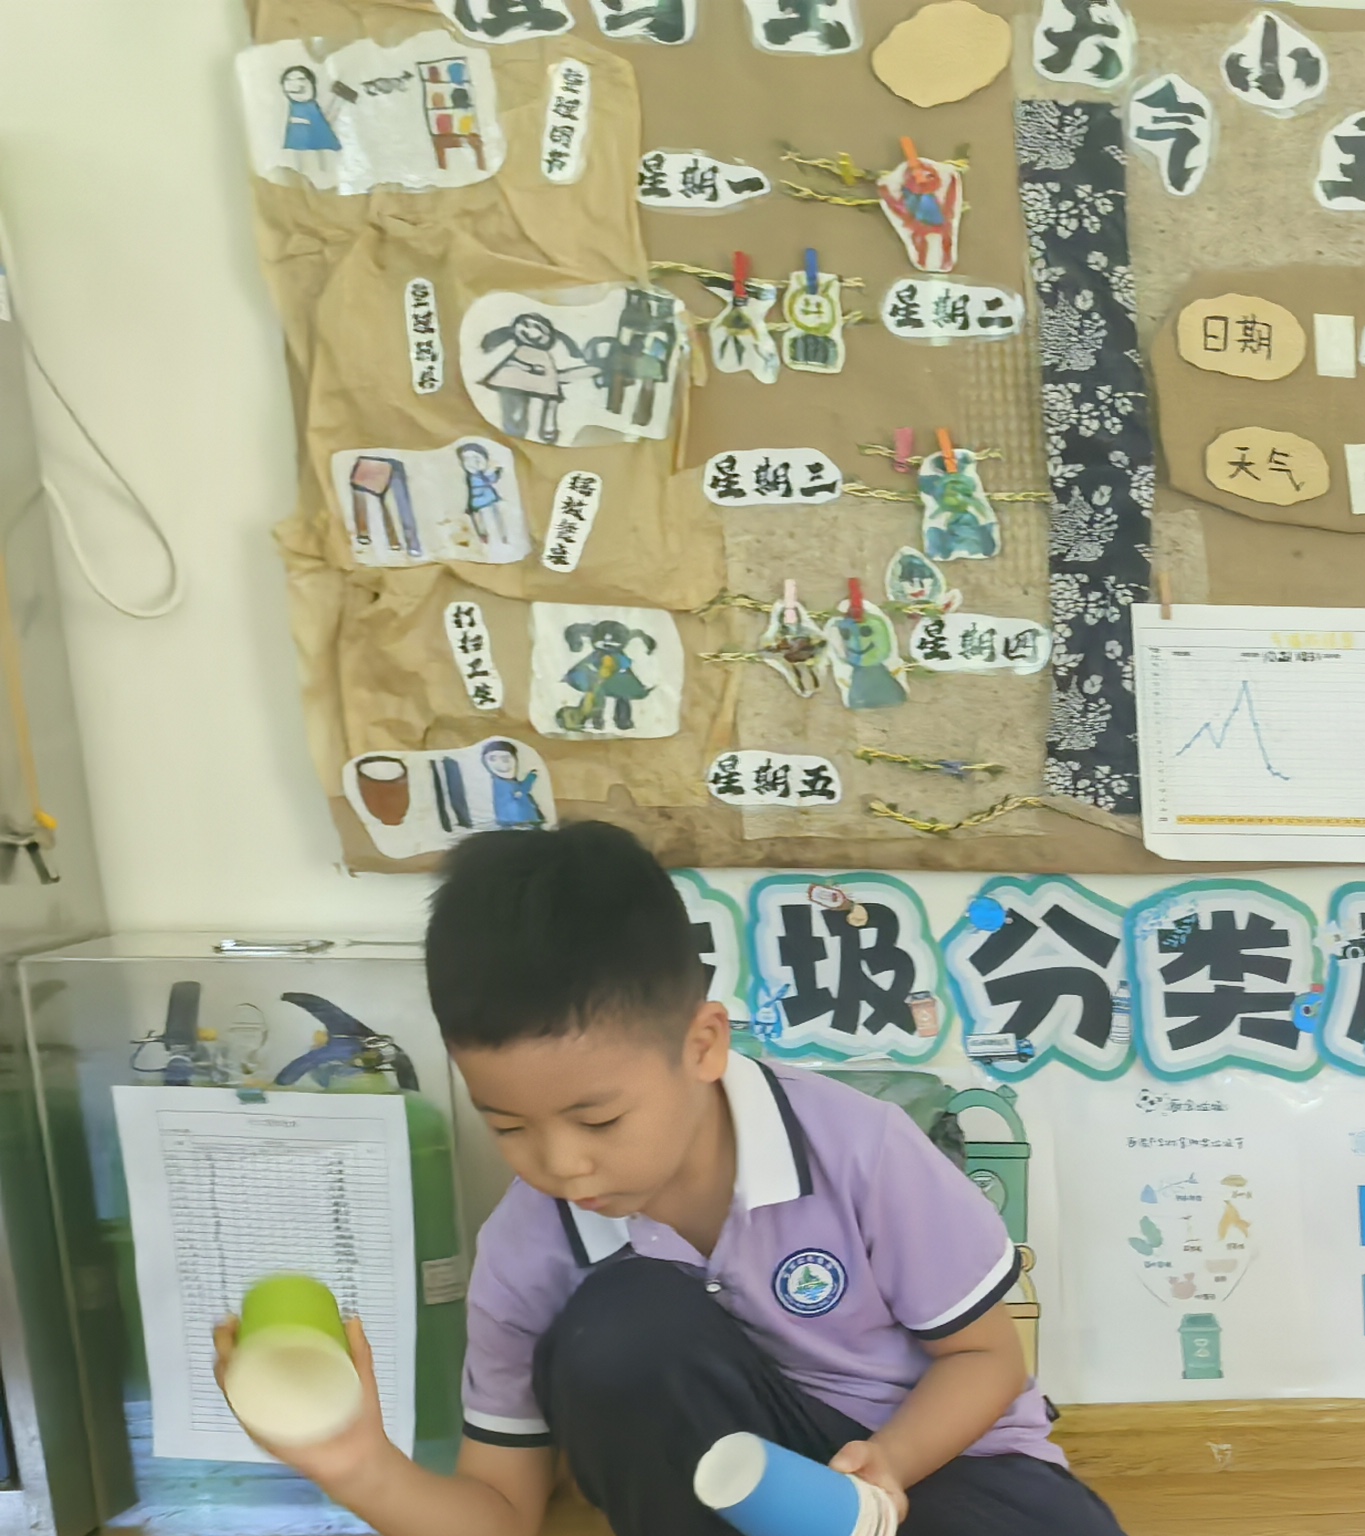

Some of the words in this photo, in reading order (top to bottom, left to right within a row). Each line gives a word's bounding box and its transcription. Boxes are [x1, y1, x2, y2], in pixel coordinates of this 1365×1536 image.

[638, 153, 764, 202] 星期一
[889, 283, 1014, 331] 星期二
[1202, 313, 1273, 361] 日期
[706, 456, 840, 498] 星期三
[1227, 446, 1304, 492] 天气
[912, 618, 1042, 662] 星期四
[707, 755, 842, 799] 星期五
